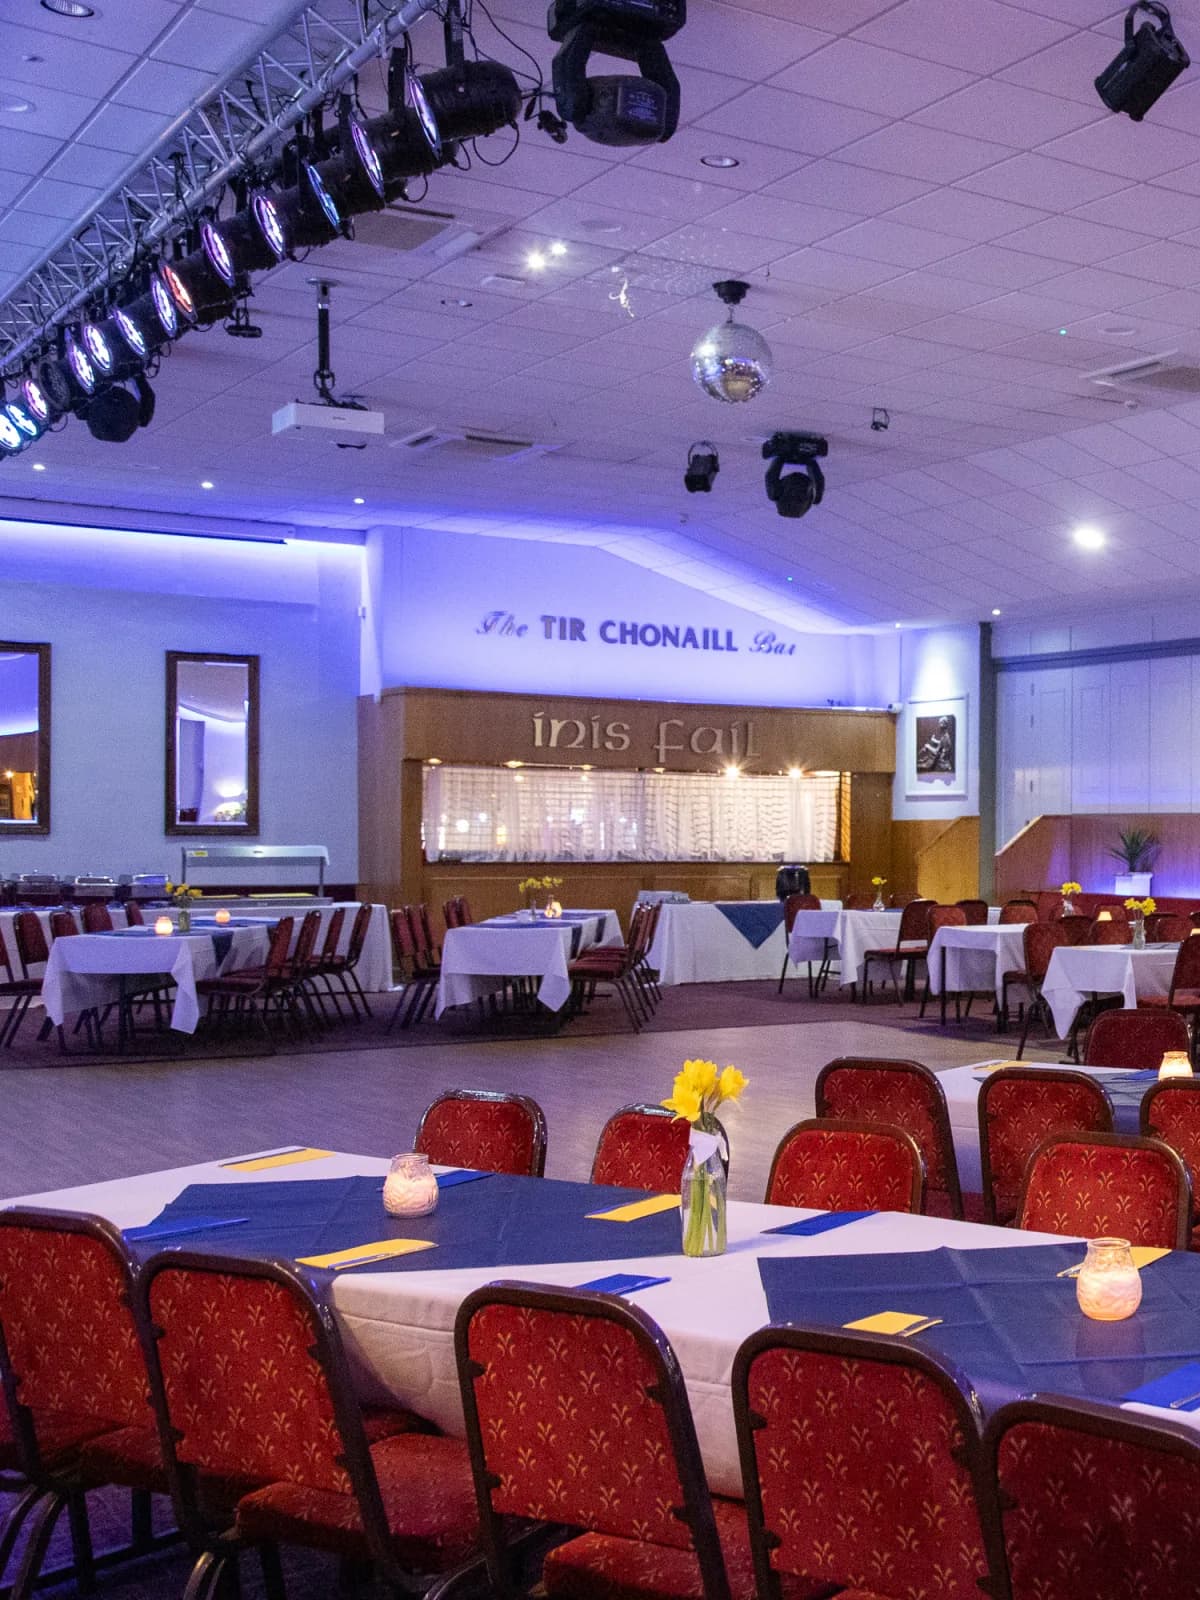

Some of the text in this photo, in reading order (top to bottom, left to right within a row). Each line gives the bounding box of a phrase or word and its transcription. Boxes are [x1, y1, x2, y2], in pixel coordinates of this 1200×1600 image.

[475, 610, 796, 656] The TIR CHONAILL Bar
